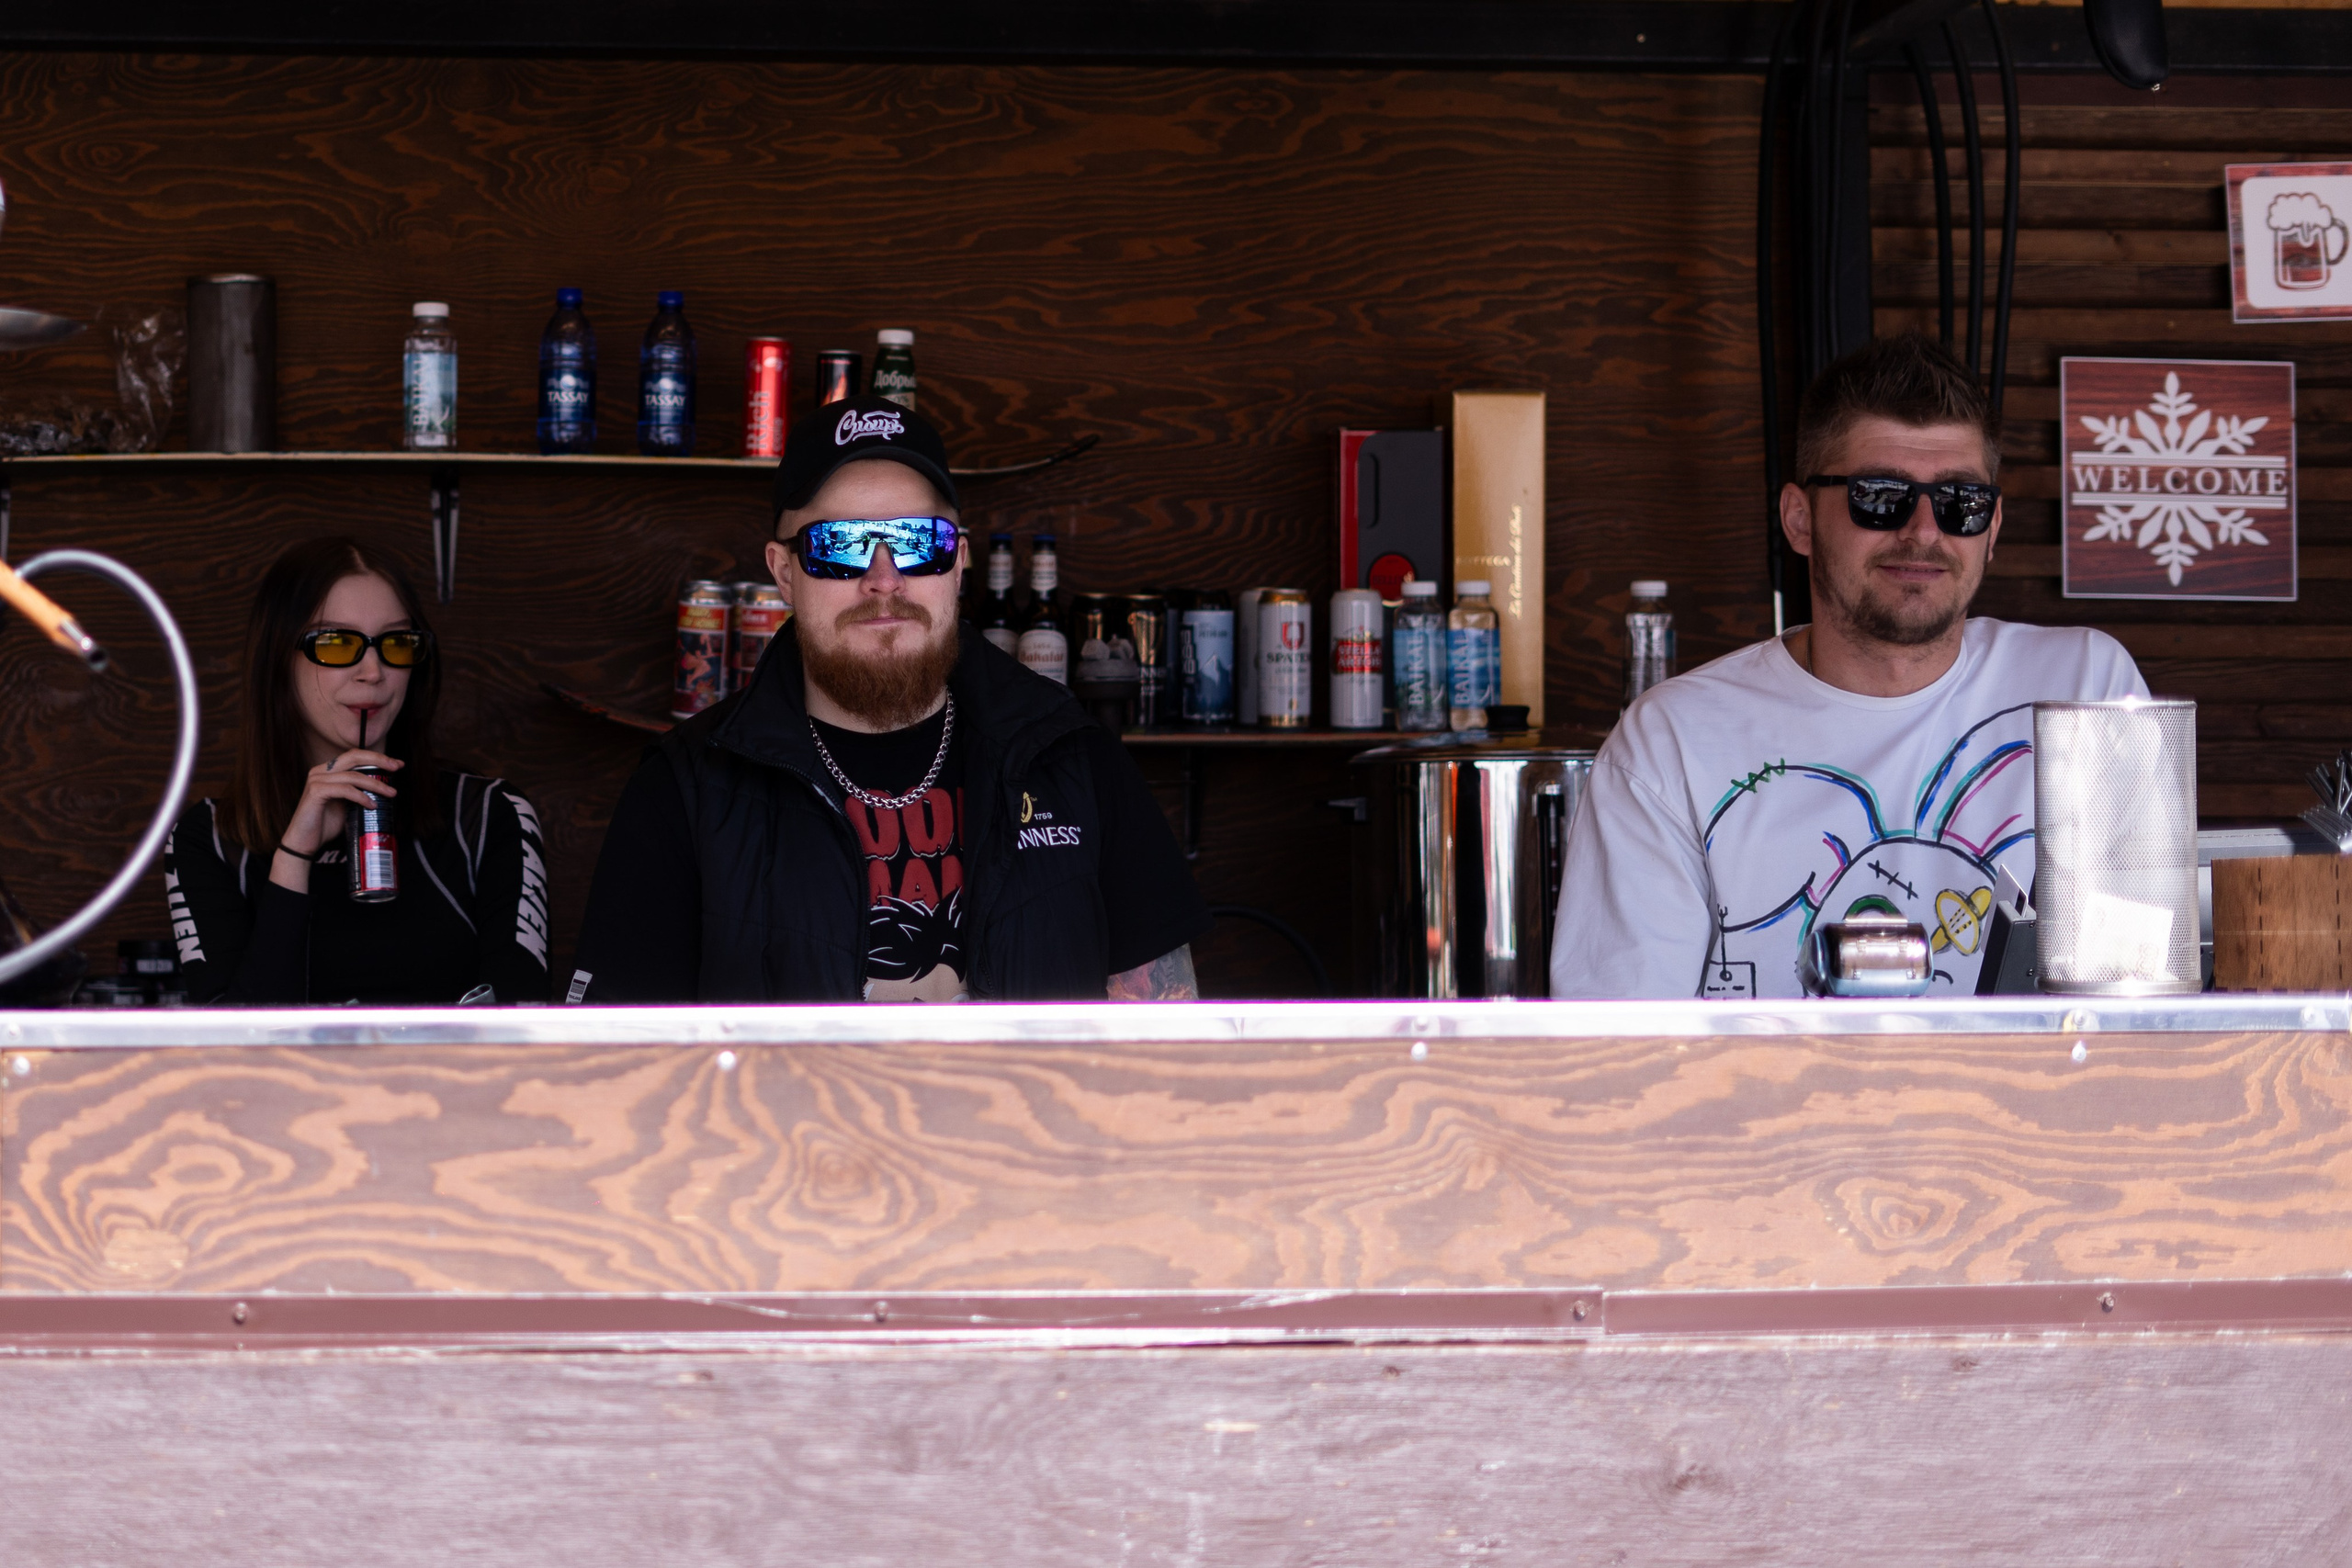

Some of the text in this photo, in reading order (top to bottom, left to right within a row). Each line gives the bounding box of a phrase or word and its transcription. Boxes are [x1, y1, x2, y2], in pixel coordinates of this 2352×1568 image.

[547, 390, 590, 407] TASSAY
[644, 394, 687, 408] TASSAY
[745, 390, 769, 450] Rich
[834, 409, 905, 446] Сибирь
[2072, 466, 2289, 496] WELCOME
[1338, 644, 1382, 656] STELLA
[1408, 630, 1425, 705] BAIKAL
[1453, 634, 1470, 705] BAIKAL
[1034, 812, 1053, 820] 1759
